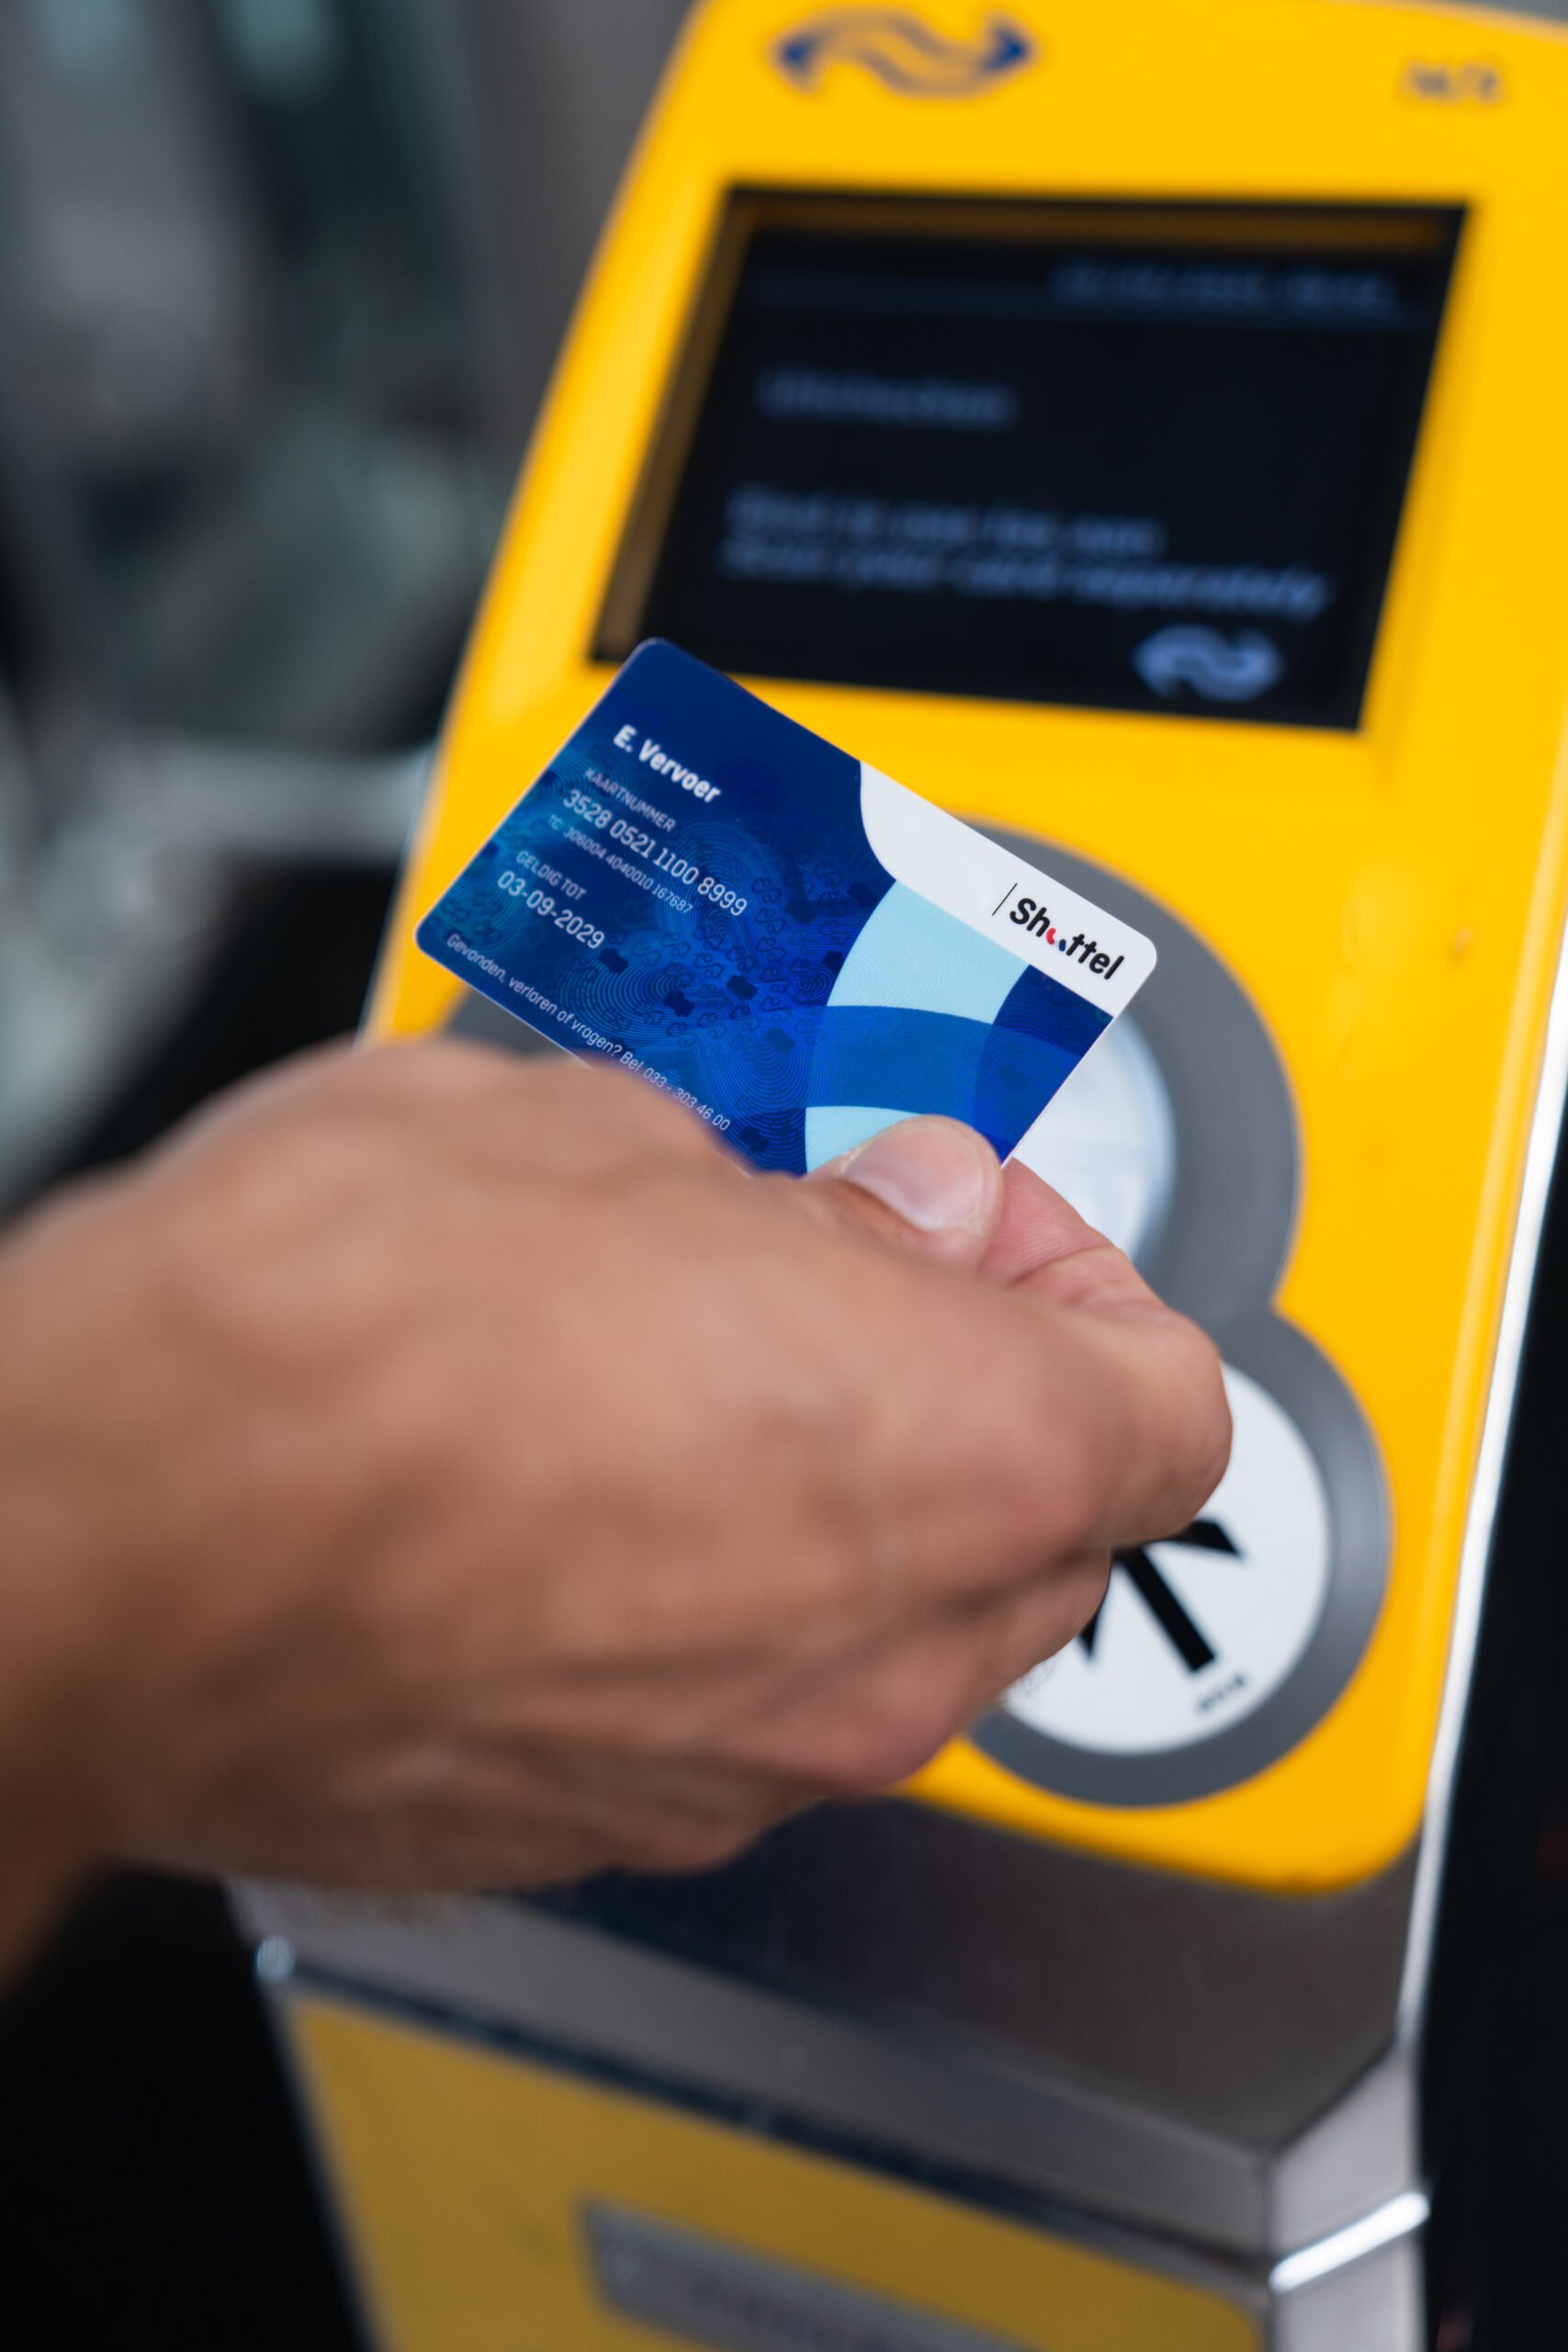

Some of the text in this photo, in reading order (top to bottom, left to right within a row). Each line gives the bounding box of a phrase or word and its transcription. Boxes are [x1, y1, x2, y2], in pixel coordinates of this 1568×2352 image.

[583, 766, 677, 832] KAARTNUMMER
[613, 724, 722, 803] E. Vervoer
[516, 850, 588, 902] GELDIG TOT
[563, 789, 749, 917] 3528 0521 1100 8999
[605, 854, 654, 890] 4040010
[651, 884, 694, 914] 167687
[497, 870, 605, 949] 03-09-2029
[1010, 898, 1125, 980] Shuttel
[446, 932, 508, 984] Gevonden,
[508, 976, 558, 1015] verloren
[556, 1009, 574, 1025] of
[571, 1017, 623, 1057] vragen?
[619, 1050, 644, 1071] Bel
[642, 1067, 668, 1088] 033
[672, 1087, 697, 1109] 303
[696, 1104, 714, 1120] 46
[712, 1114, 731, 1131] 00
